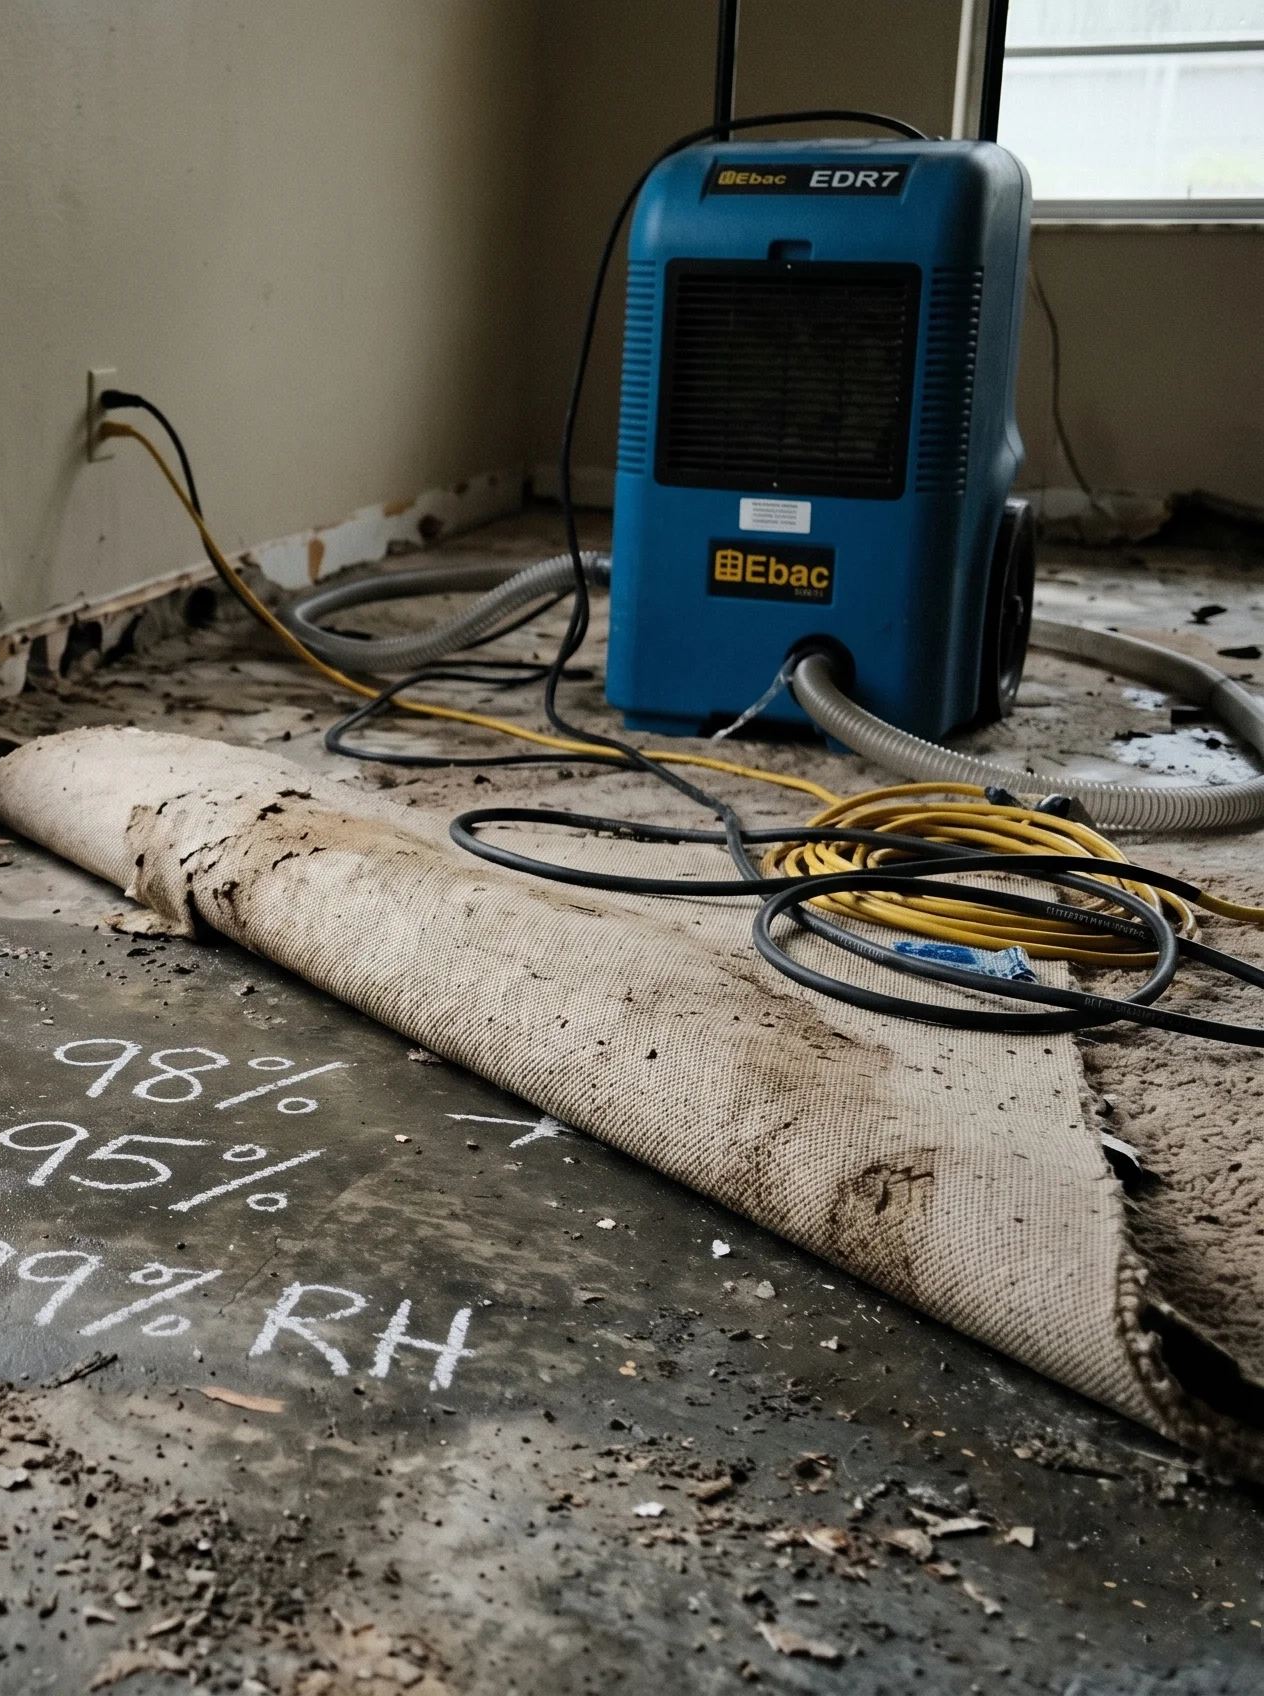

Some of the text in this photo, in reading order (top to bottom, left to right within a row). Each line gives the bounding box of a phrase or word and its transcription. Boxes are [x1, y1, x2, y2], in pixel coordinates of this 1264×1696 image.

[736, 170, 900, 187] Ebac EDR7
[745, 554, 830, 589] Ebac
[53, 1037, 353, 1115] 98%
[248, 1282, 476, 1392] RH
